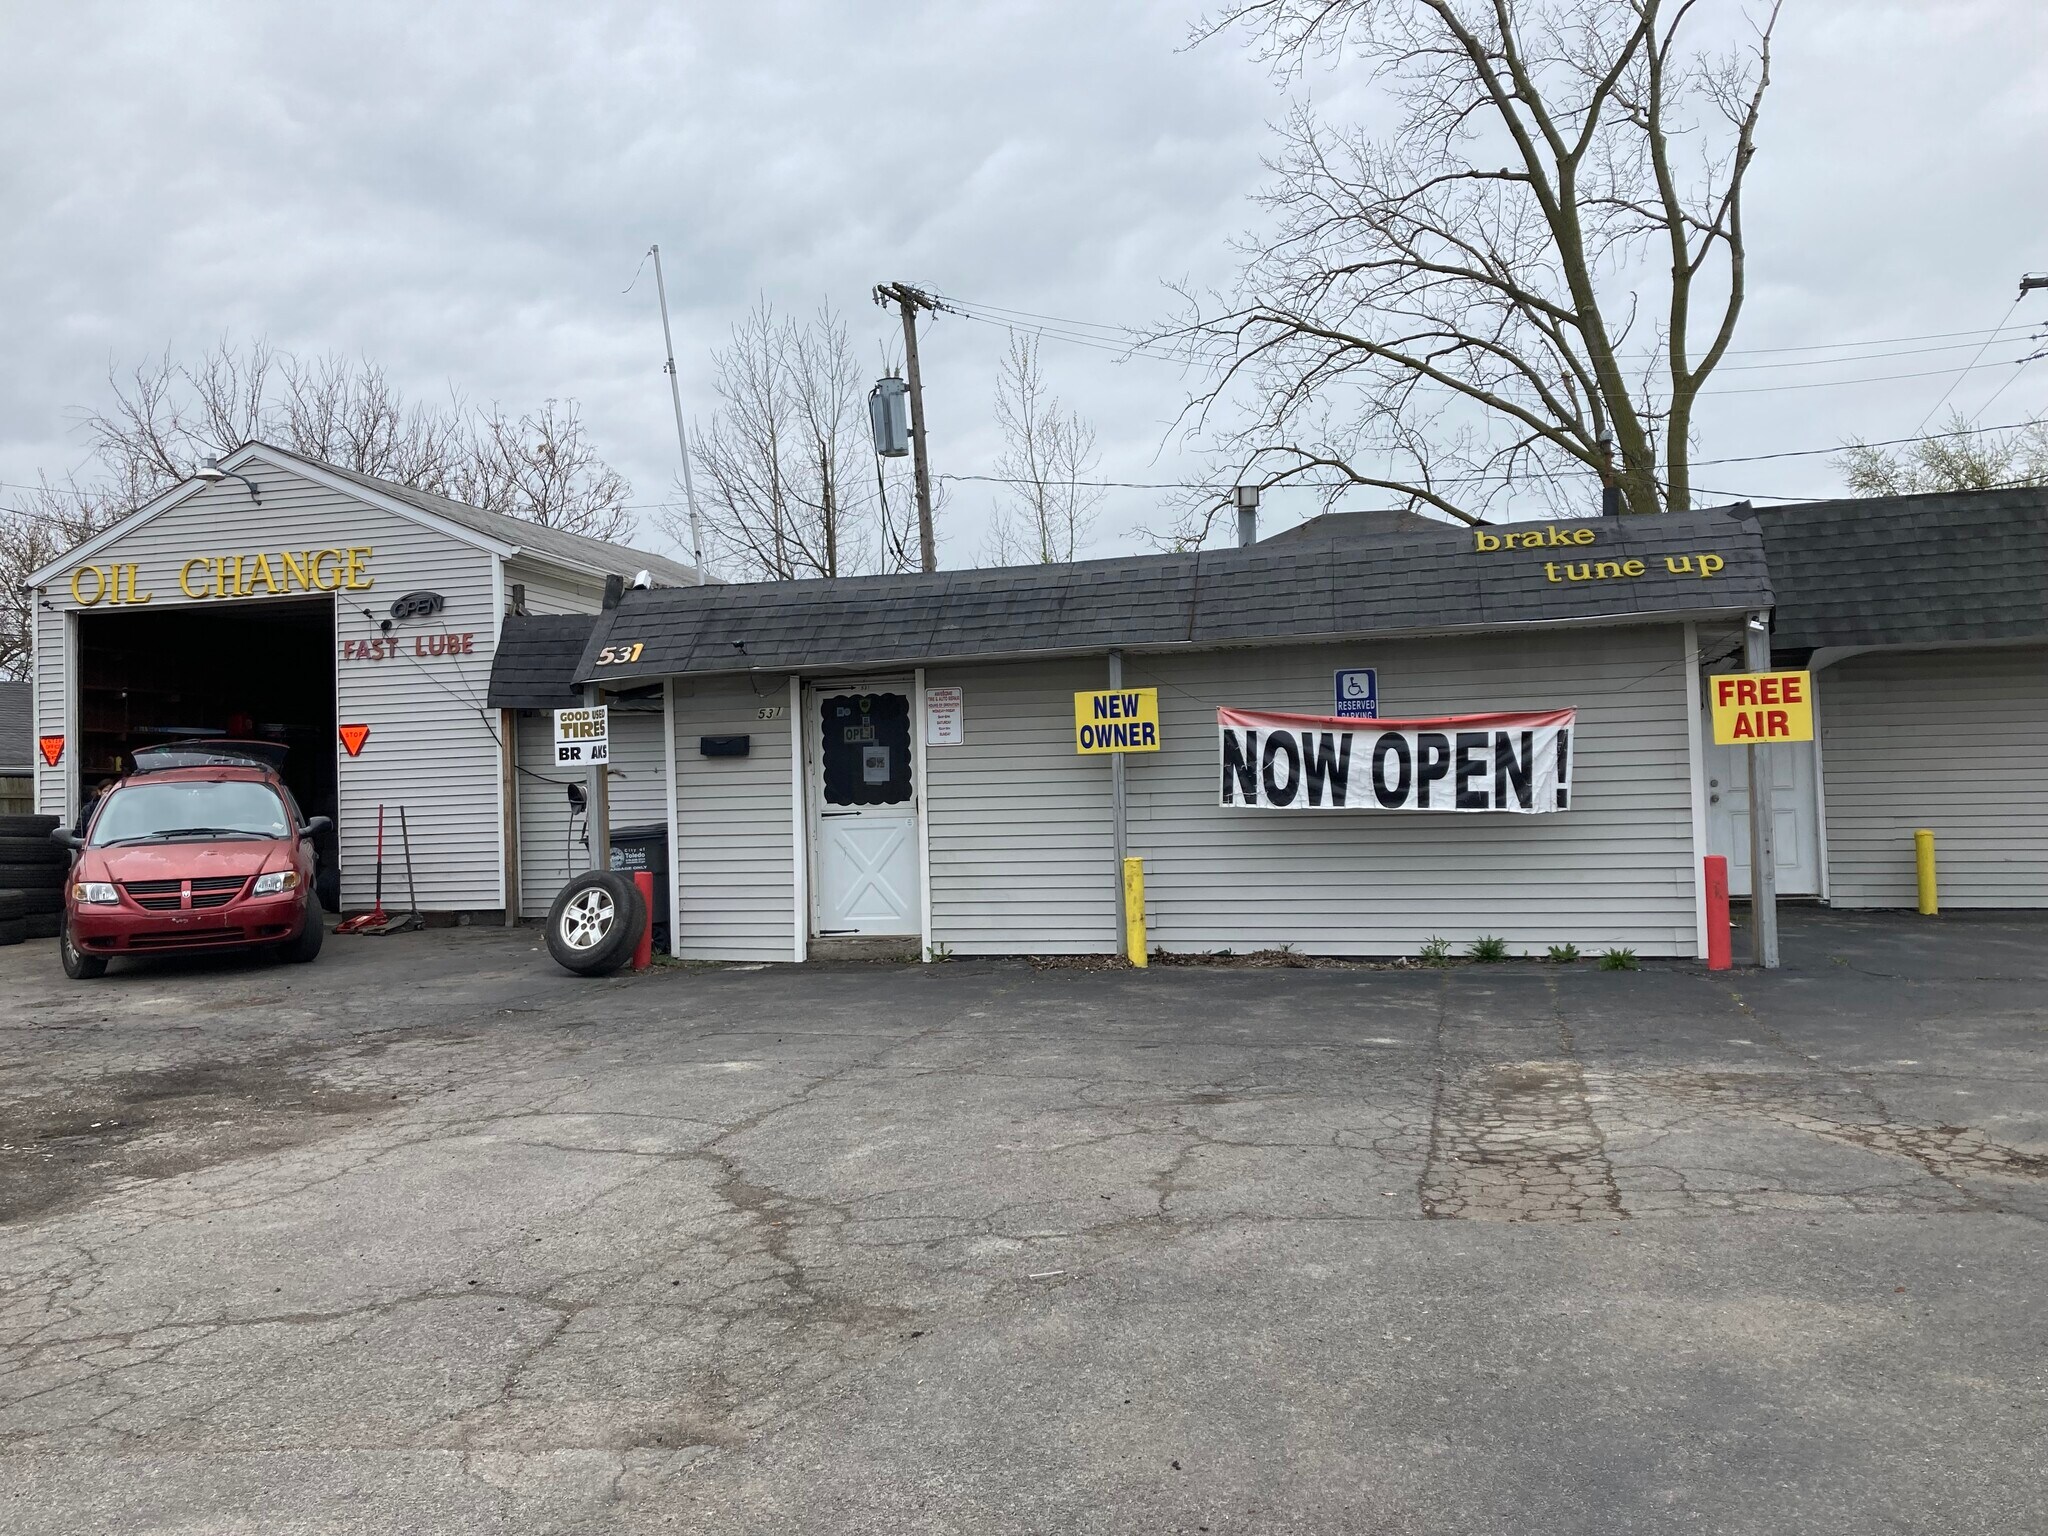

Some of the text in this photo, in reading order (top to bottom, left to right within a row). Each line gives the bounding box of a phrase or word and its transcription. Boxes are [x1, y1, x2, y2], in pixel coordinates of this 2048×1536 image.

[1474, 526, 1596, 552] brake
[71, 546, 375, 606] OIL CHANGE
[1544, 554, 1725, 583] tune up
[393, 597, 443, 617] OPEN
[343, 633, 474, 661] FAST LUBE
[596, 643, 644, 666] 531
[1717, 676, 1803, 707] FREE
[560, 709, 605, 722] GOOD USED
[758, 706, 781, 719] 531
[1093, 693, 1139, 719] NEW
[1338, 700, 1375, 711] RESERVED
[561, 720, 605, 739] TIRES
[1080, 722, 1156, 749] OWNER
[1732, 710, 1790, 739] AIR
[559, 745, 607, 760] BR AKS
[1222, 729, 1353, 807] NOW
[1372, 730, 1533, 809] OPEN
